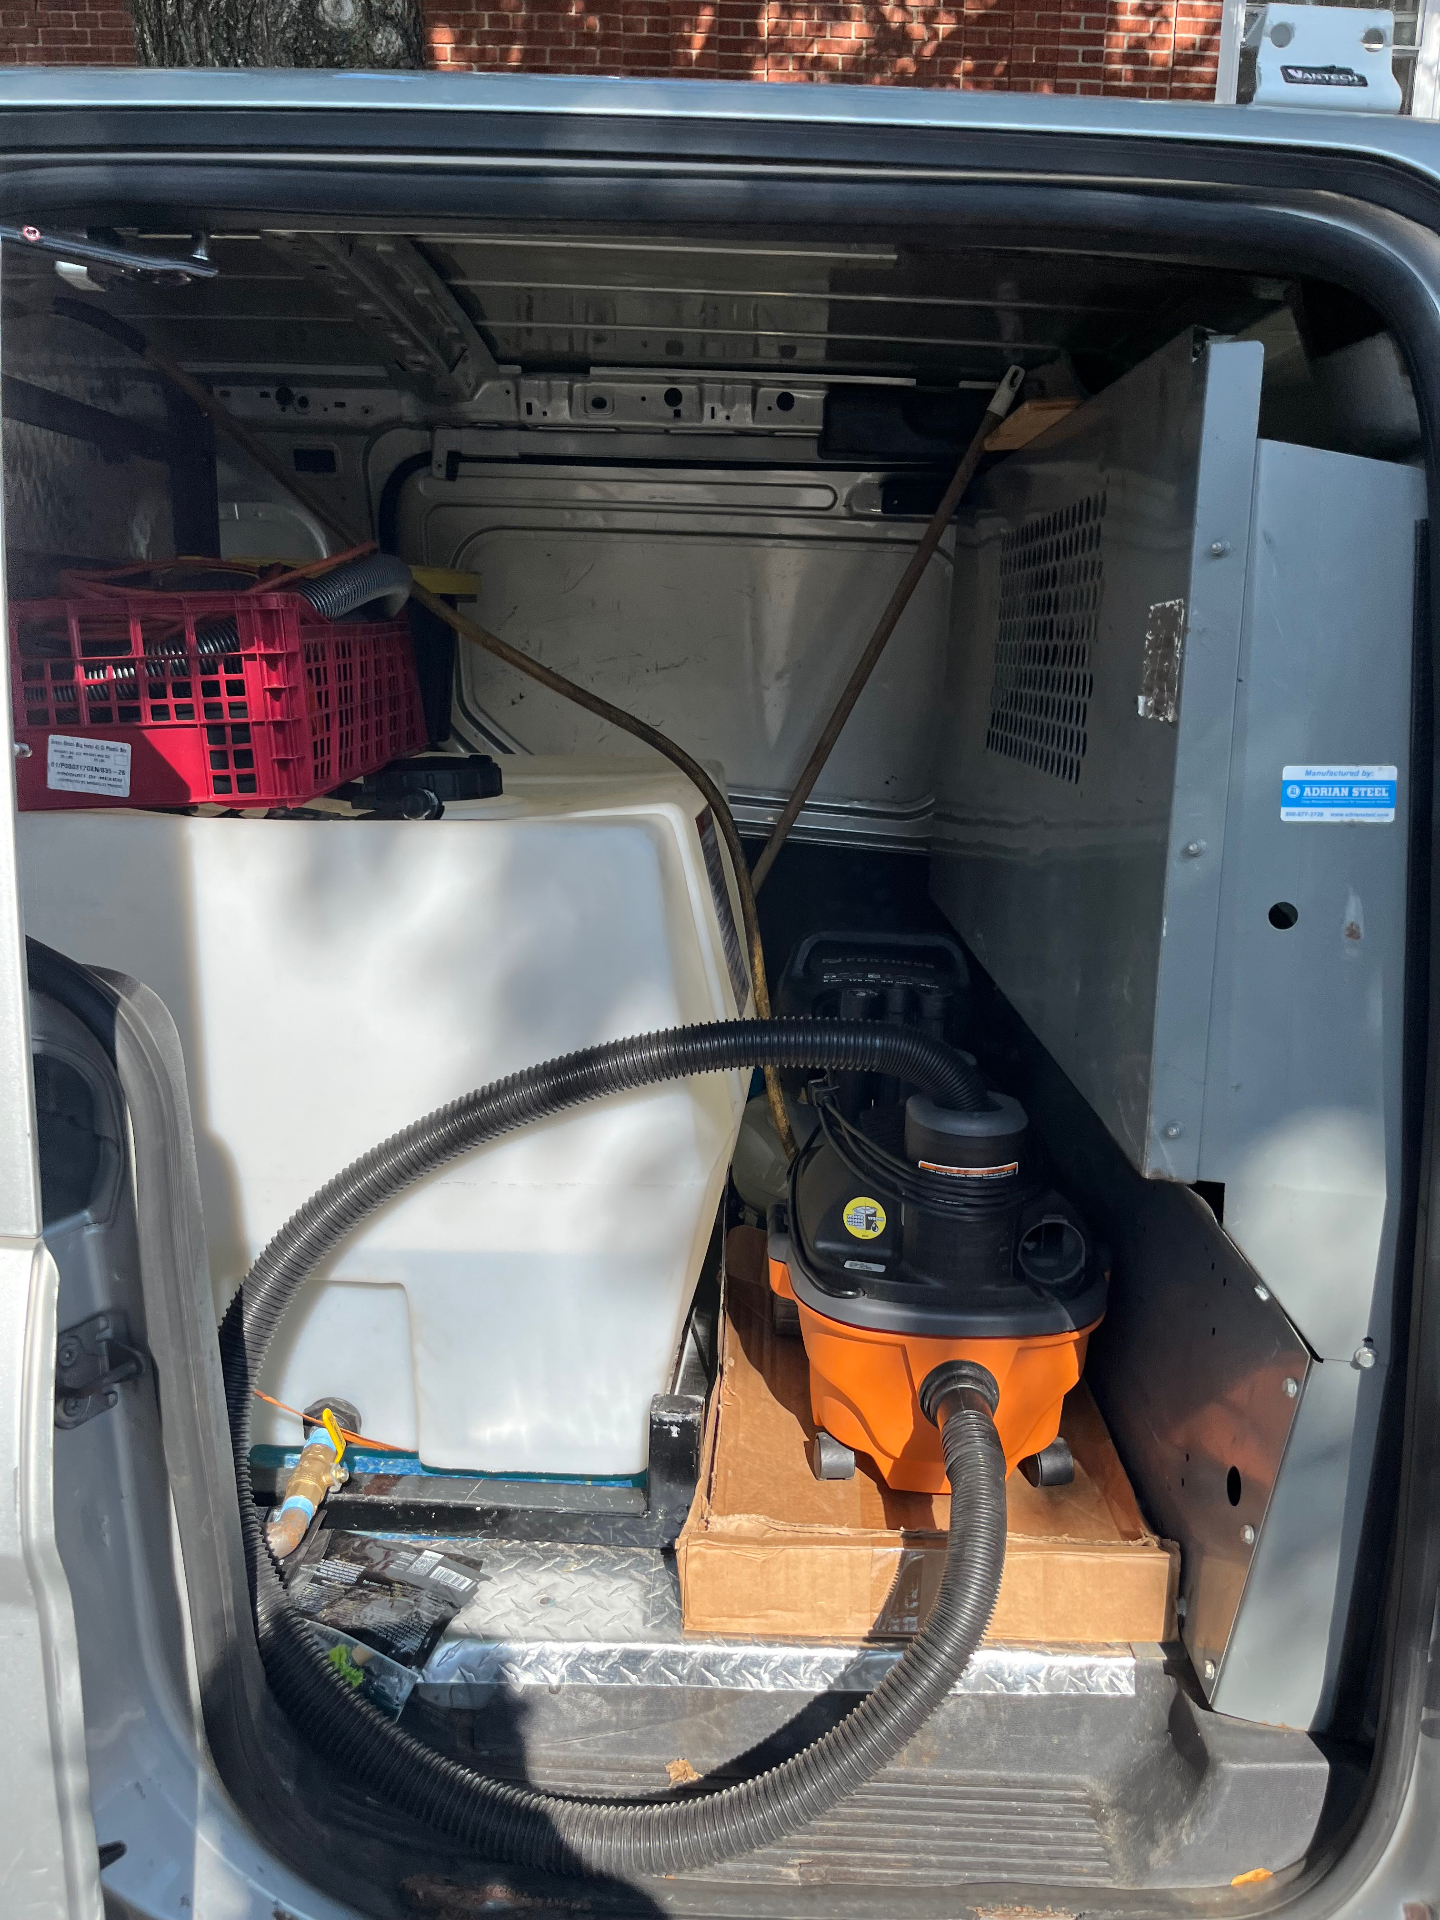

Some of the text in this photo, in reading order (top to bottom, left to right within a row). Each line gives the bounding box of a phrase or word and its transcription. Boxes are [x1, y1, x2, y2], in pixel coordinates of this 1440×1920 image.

[1287, 69, 1359, 82] VANTECH
[1305, 769, 1374, 778] Manufactured by:
[1303, 787, 1389, 797] ADRIAN STEEL
